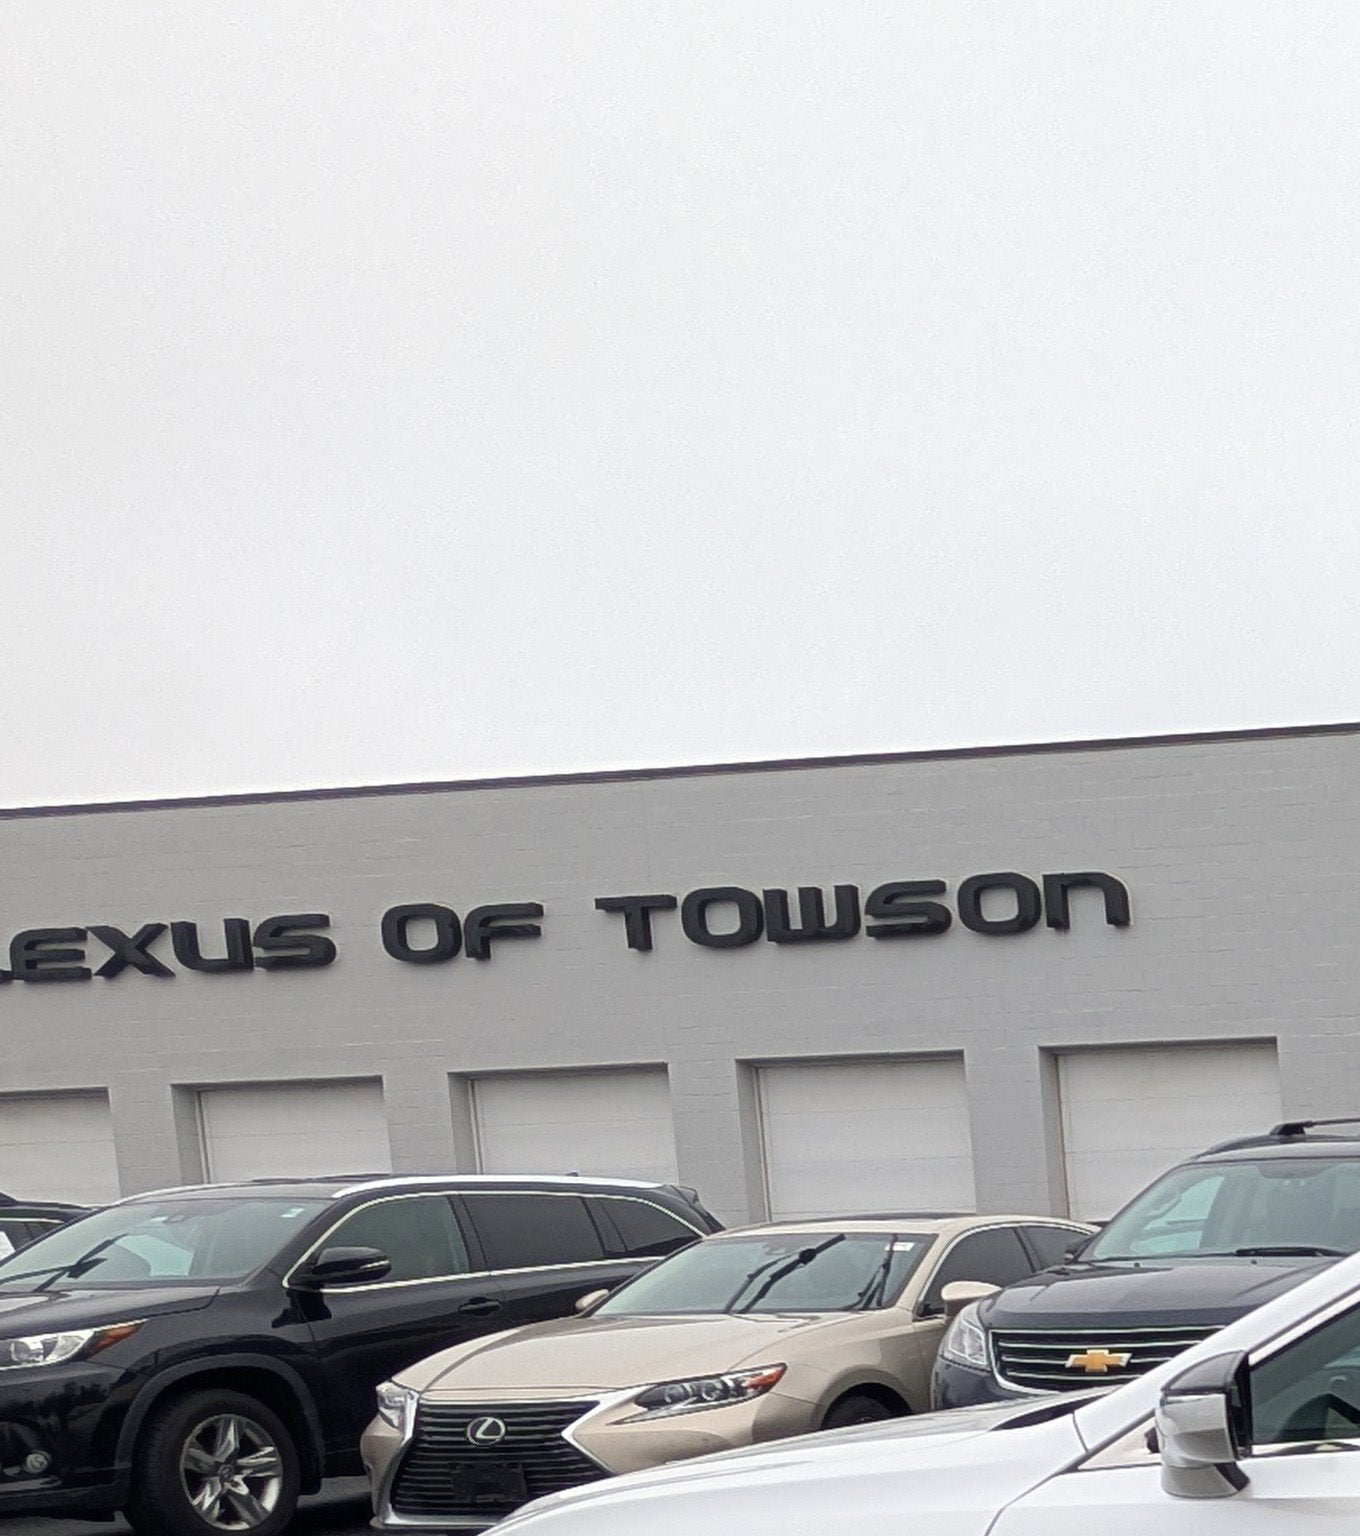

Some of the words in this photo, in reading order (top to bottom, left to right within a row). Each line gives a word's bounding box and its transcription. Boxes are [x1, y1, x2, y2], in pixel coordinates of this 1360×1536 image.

[0, 913, 337, 981] EXUS
[380, 902, 545, 965] OF
[594, 871, 1131, 951] TOWSON
